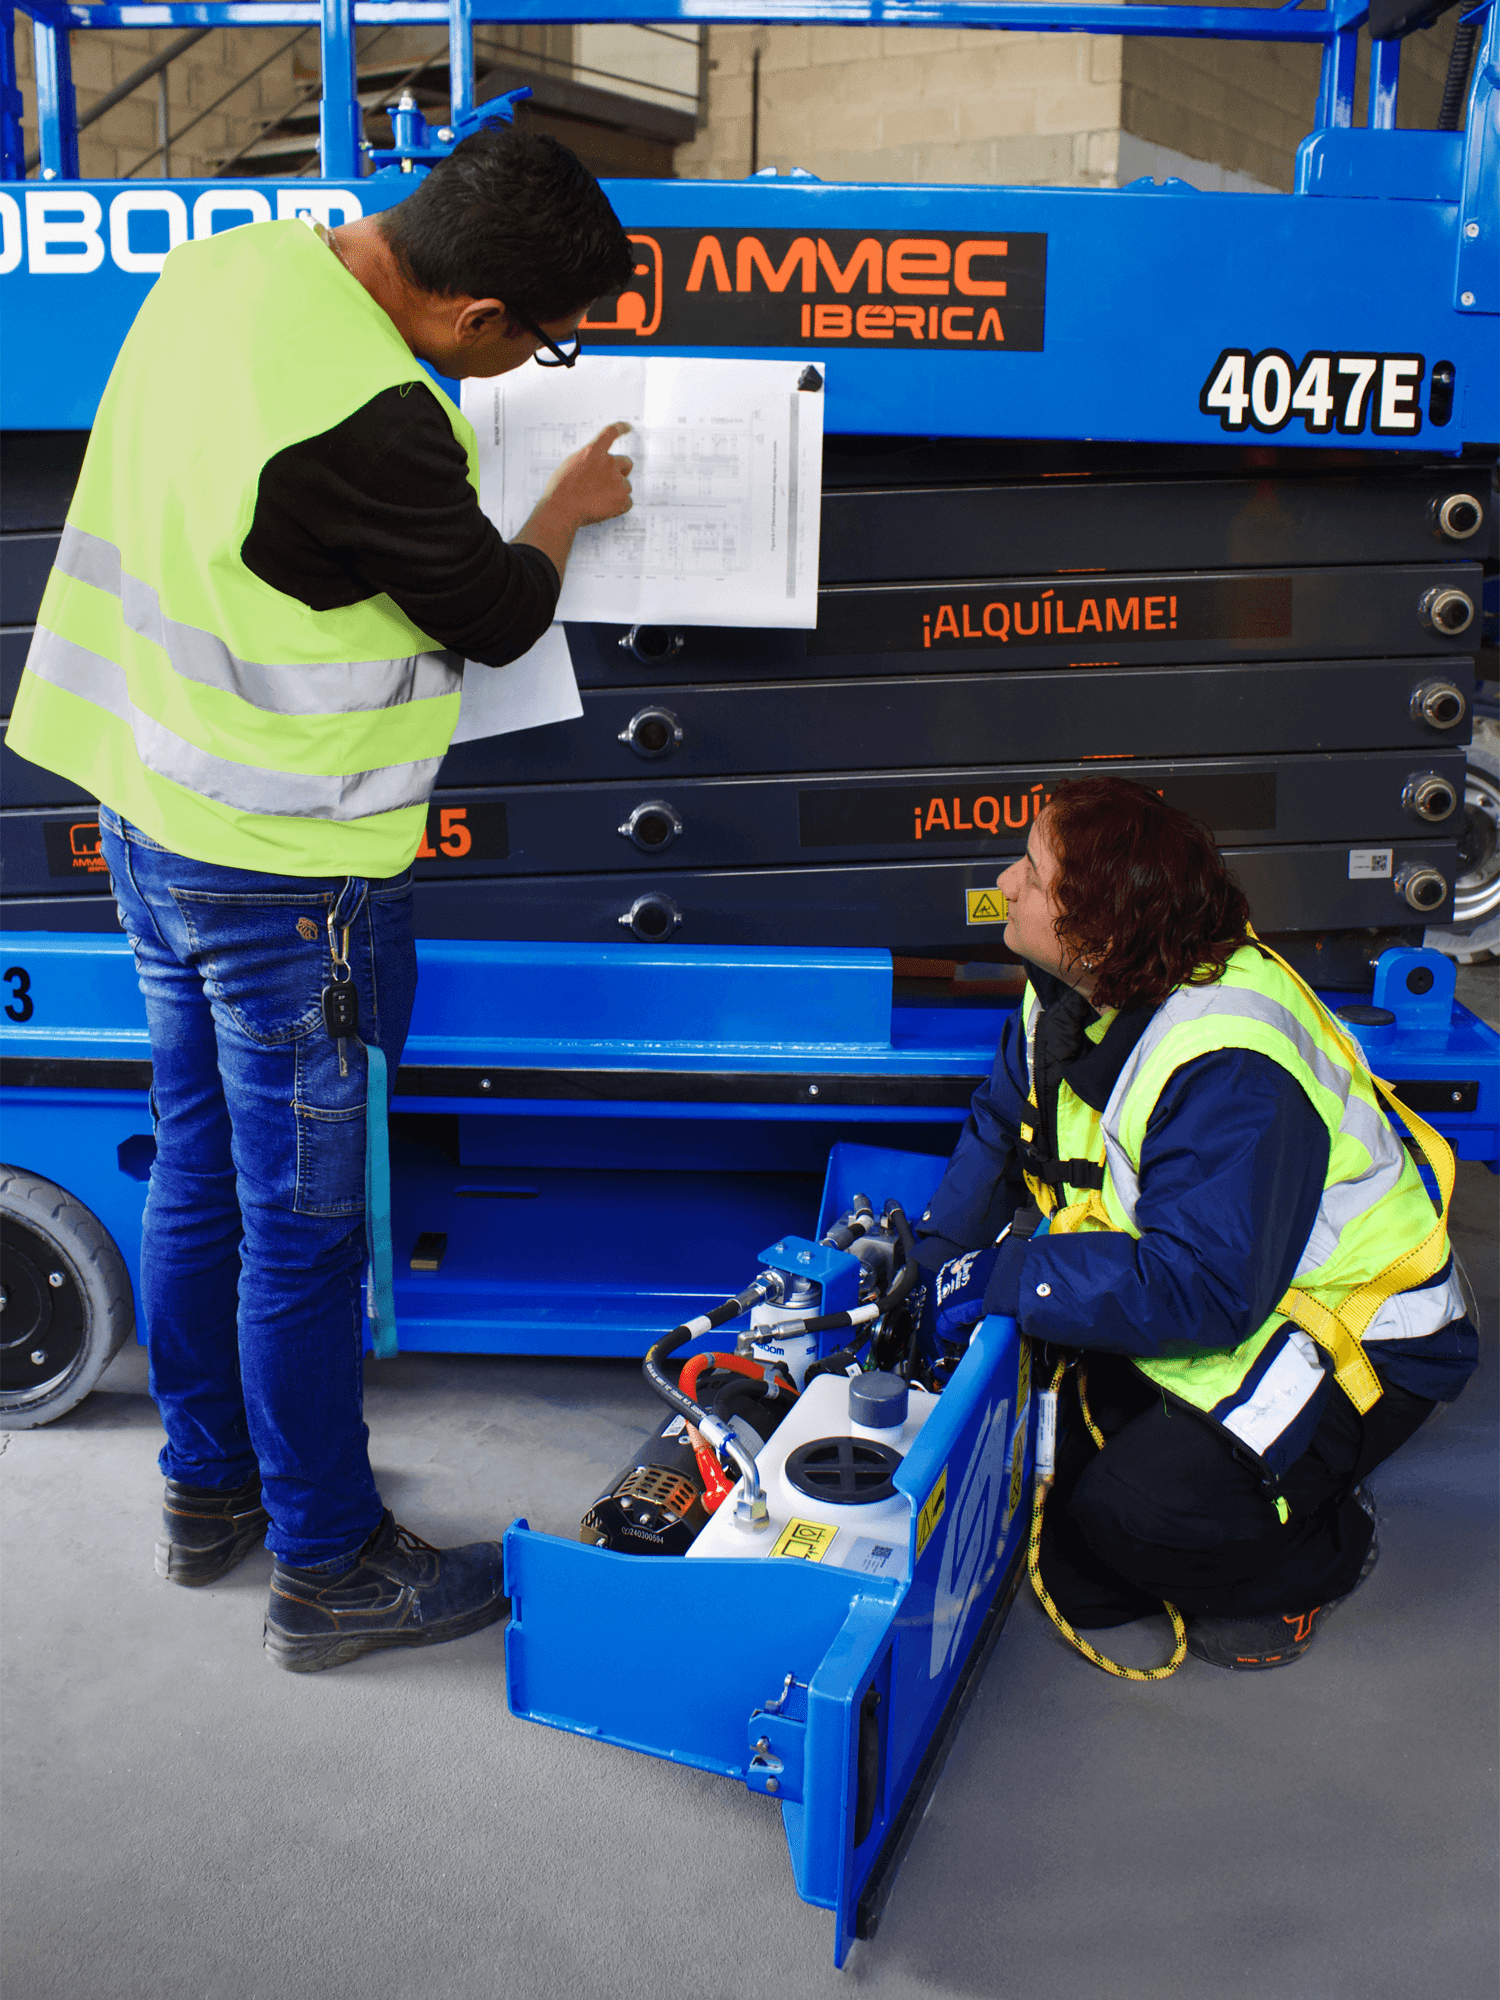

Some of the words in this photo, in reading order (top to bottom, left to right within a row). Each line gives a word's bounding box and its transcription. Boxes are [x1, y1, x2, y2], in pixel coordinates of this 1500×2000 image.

[685, 235, 1008, 296] AMMEC
[800, 303, 1005, 341] IBERICA
[1206, 354, 1419, 429] 4047E
[922, 589, 1177, 648] ¡ALQUÍLAME!
[3, 966, 34, 1023] 3
